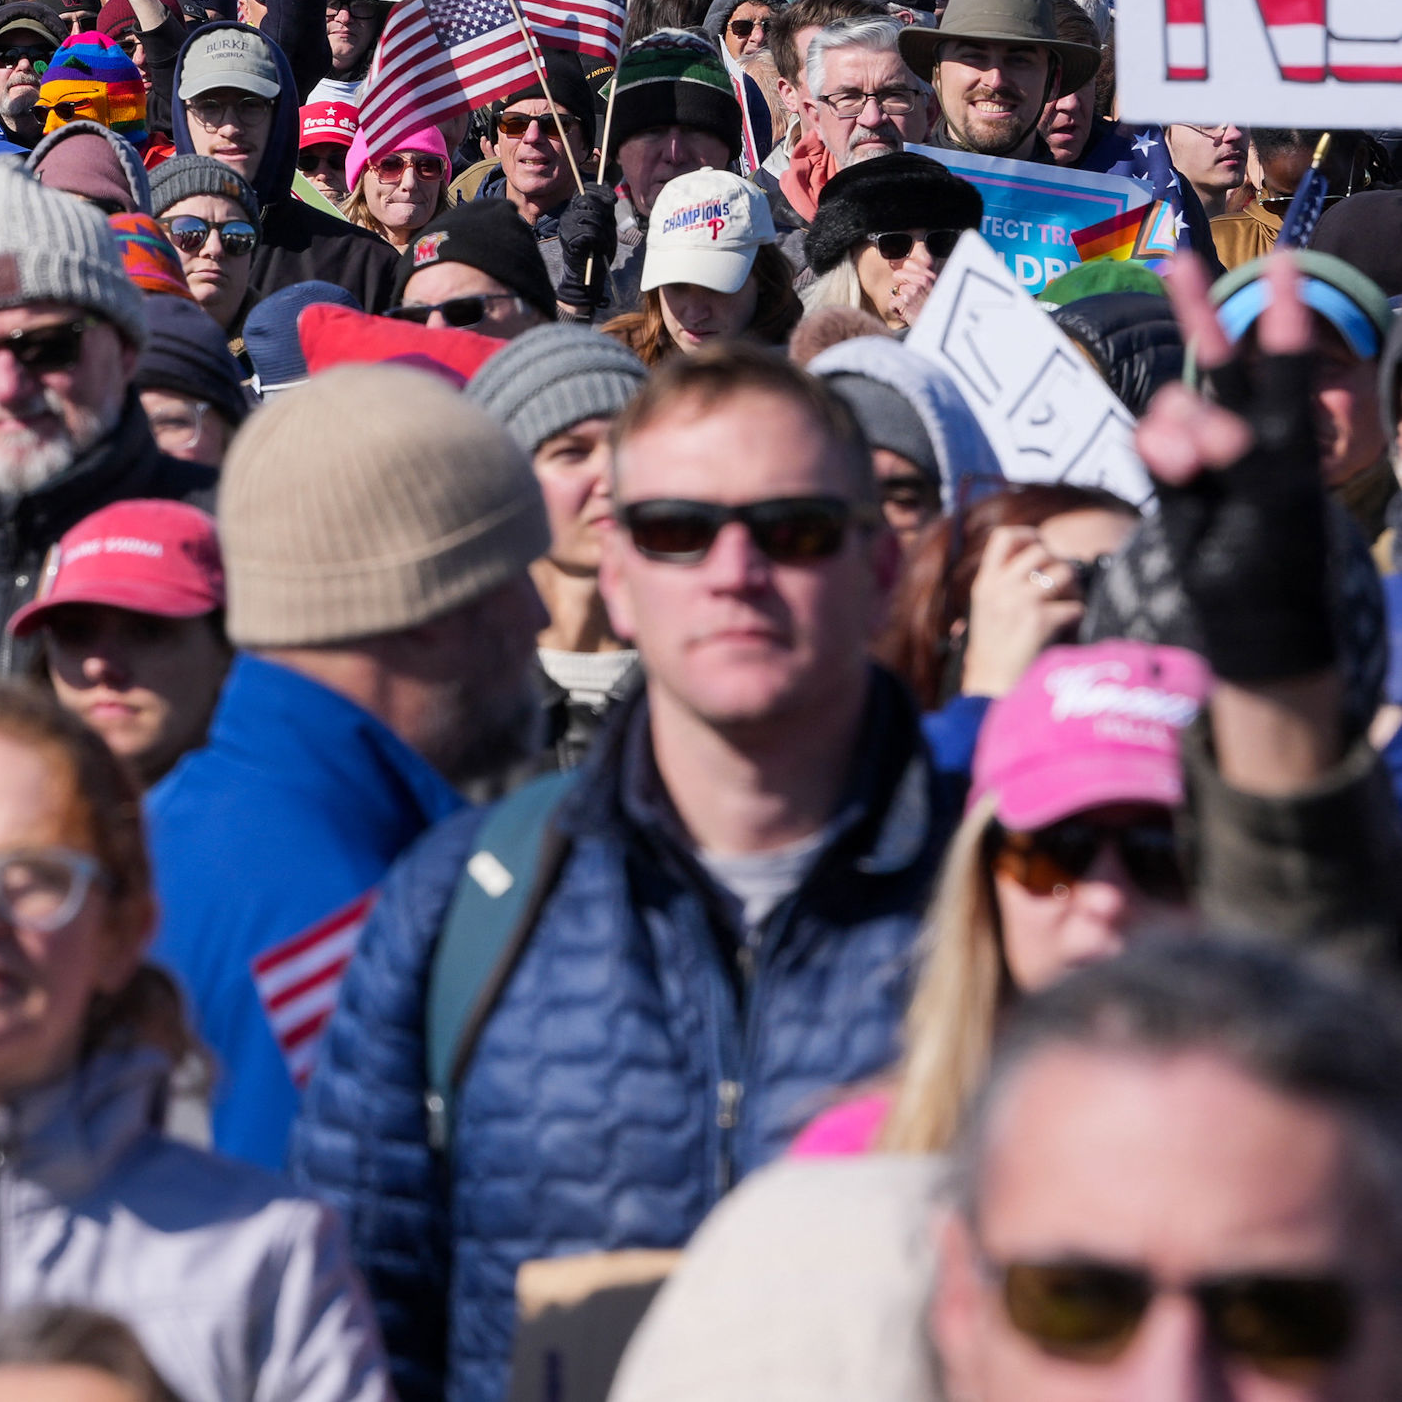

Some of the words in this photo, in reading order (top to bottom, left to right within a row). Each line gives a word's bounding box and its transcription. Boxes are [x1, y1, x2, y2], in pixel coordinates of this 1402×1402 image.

[207, 39, 250, 54] BURKE
[211, 51, 245, 61] VIRGINIA
[304, 117, 336, 128] free
[339, 117, 357, 131] dc
[663, 202, 730, 234] CHAMPIONS
